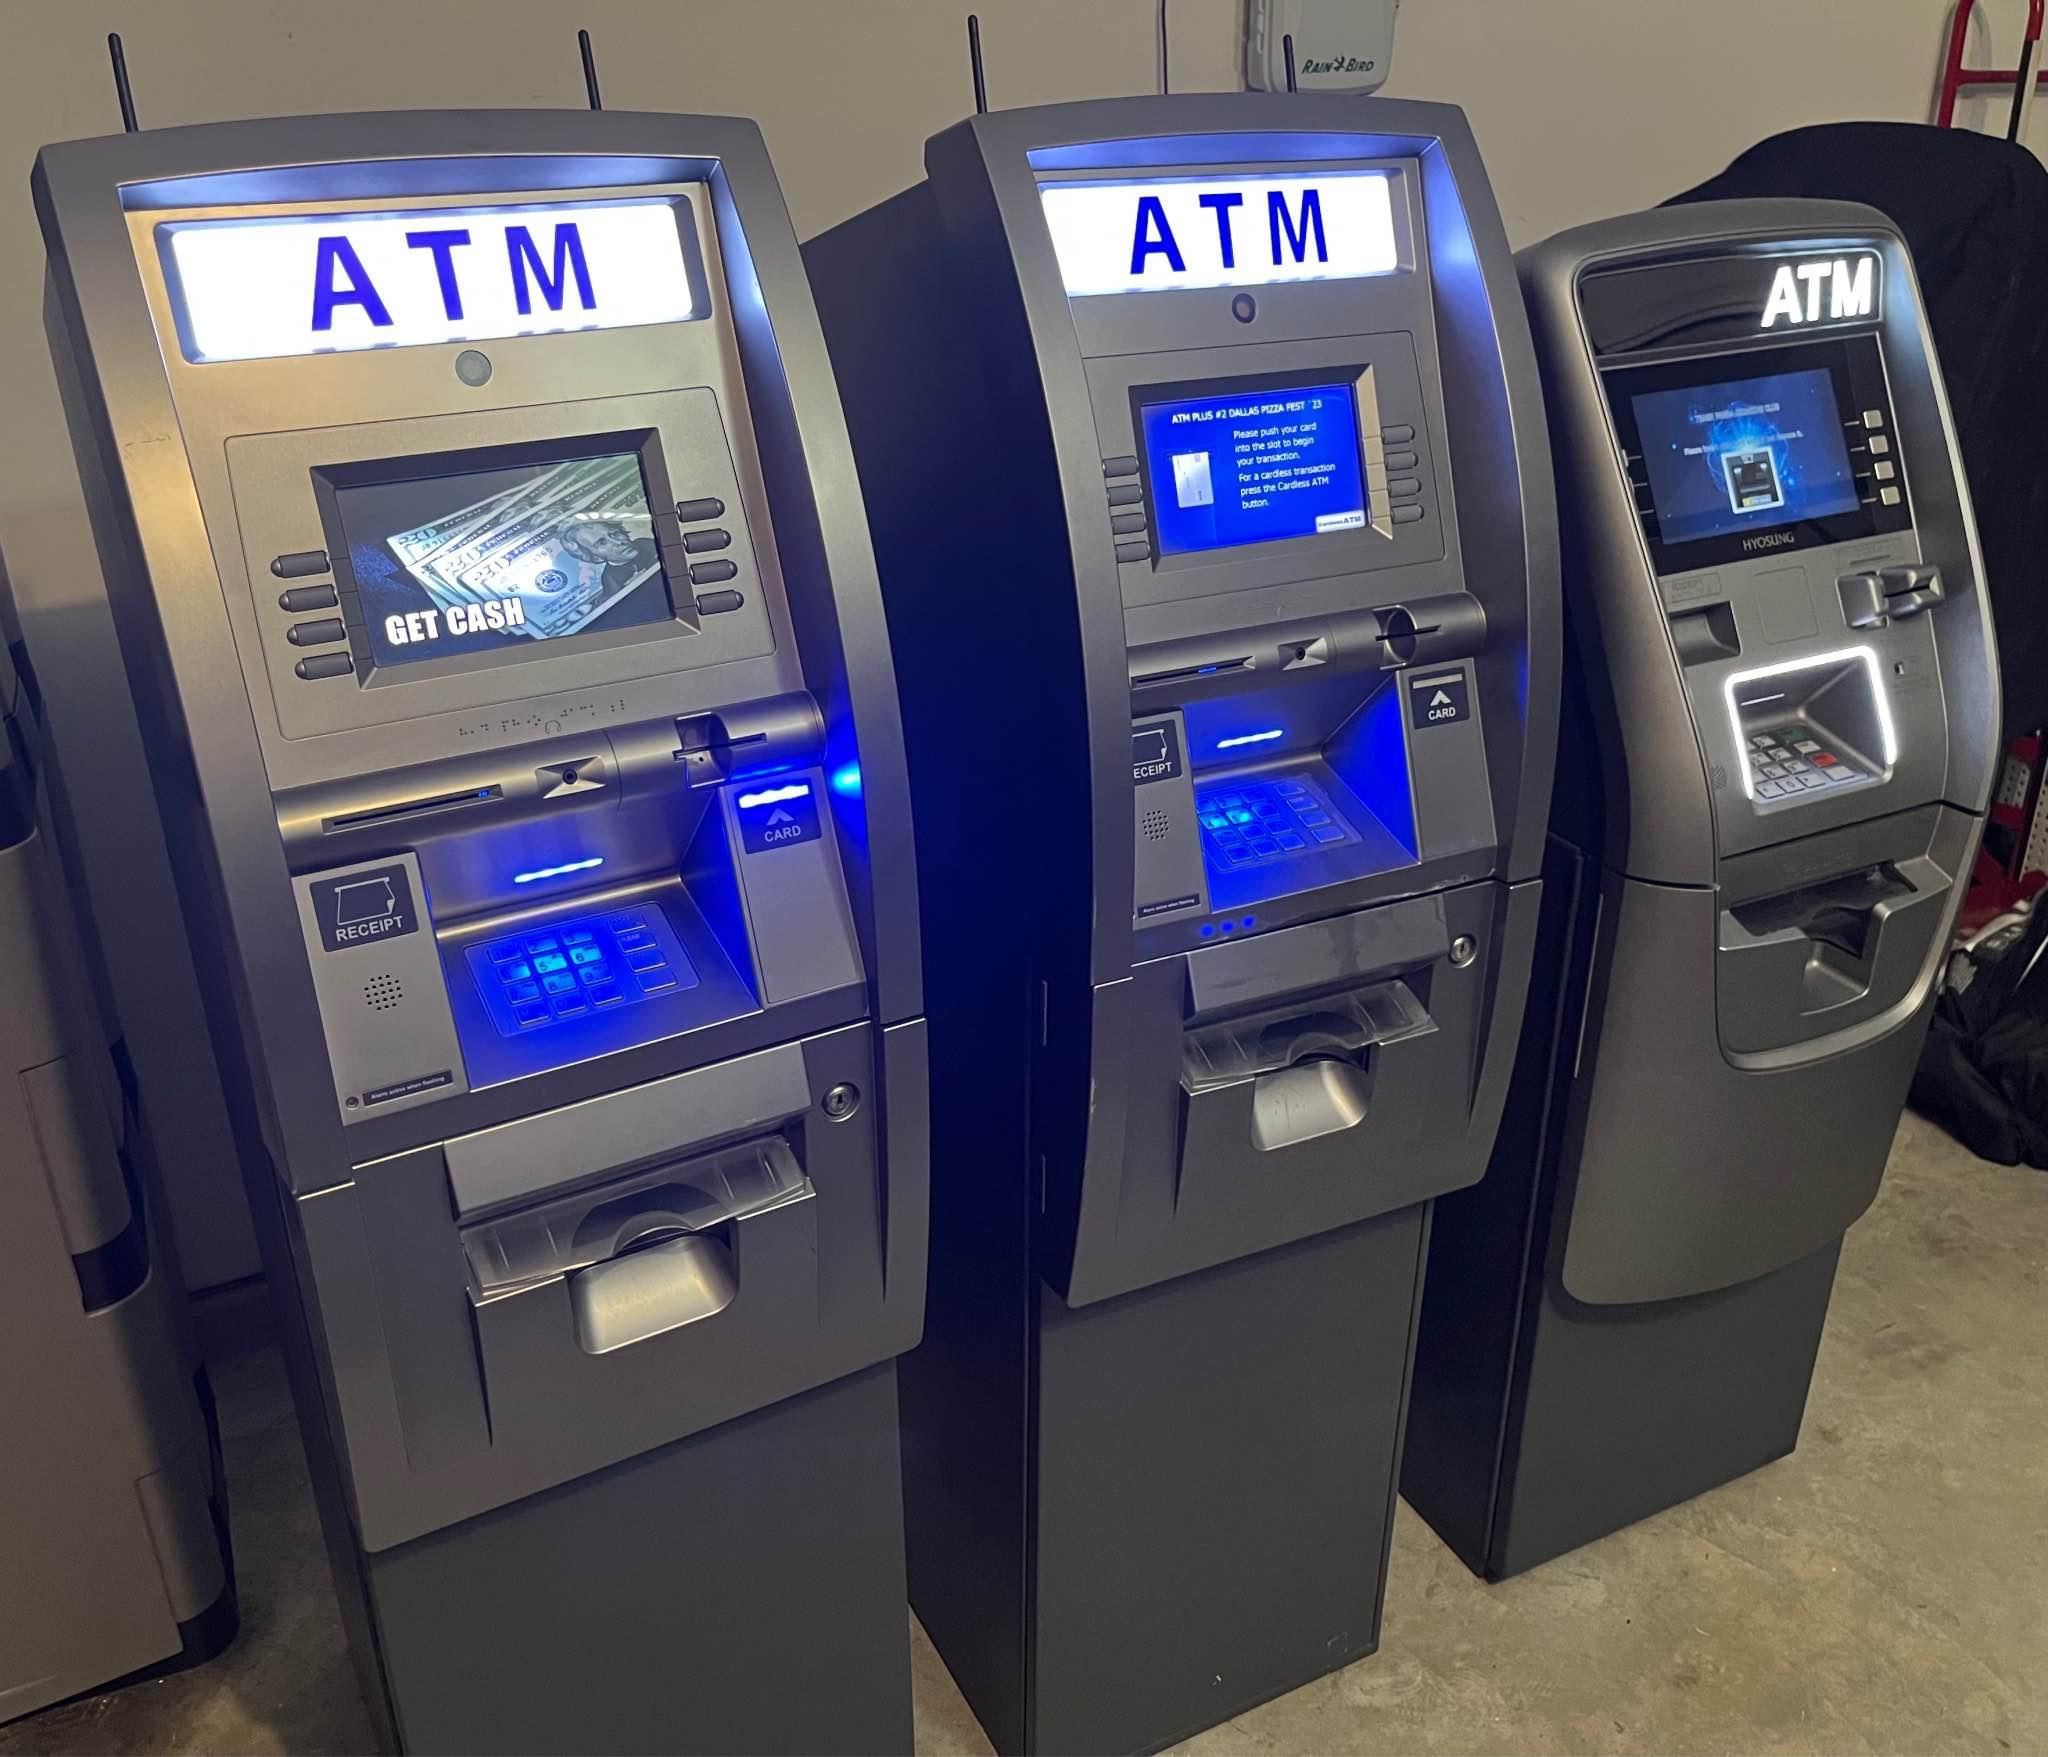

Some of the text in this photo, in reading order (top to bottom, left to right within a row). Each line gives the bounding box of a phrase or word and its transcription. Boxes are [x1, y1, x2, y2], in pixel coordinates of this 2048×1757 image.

[1130, 188, 1329, 274] ATM
[311, 222, 597, 331] ATM
[1760, 257, 1873, 328] ATM
[1171, 413, 1191, 424] ATM
[1192, 410, 1214, 422] PLUS
[1215, 409, 1227, 419] #2
[1228, 406, 1260, 418] DALLAS
[1261, 403, 1285, 414] PIZZA
[1285, 401, 1306, 412] FEST
[1233, 422, 1317, 440] Please push your card
[1234, 436, 1315, 453] into the slot to begin
[1236, 452, 1301, 469] your transaction.
[1238, 462, 1336, 482] For a cardless transaction
[1240, 476, 1329, 497] press the Cardless ATM
[1242, 498, 1269, 509] button.
[1742, 531, 1795, 551] HYOSUNG
[384, 610, 439, 646] GET
[445, 597, 526, 635] CASH
[1428, 706, 1456, 721] CARD
[1133, 762, 1172, 779] ECEIPT
[764, 825, 802, 843] CARD
[335, 915, 403, 942] RECEIPT
